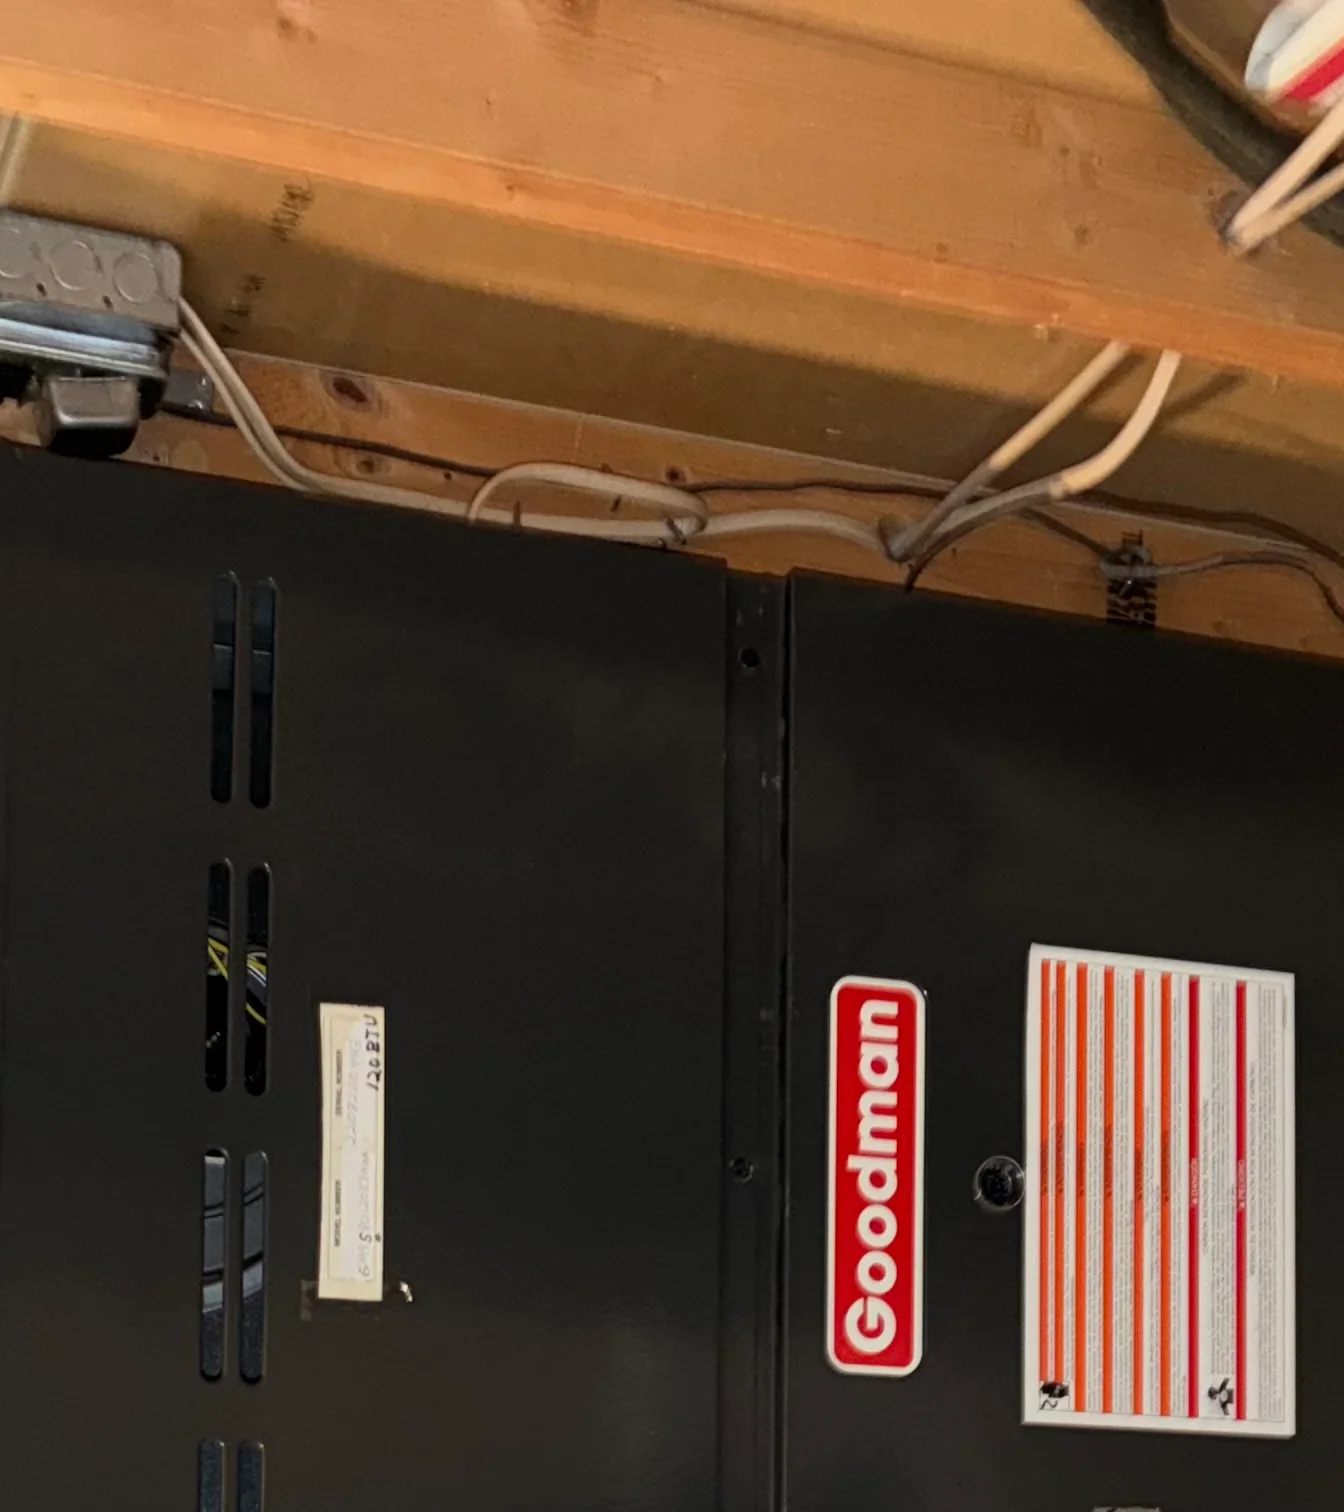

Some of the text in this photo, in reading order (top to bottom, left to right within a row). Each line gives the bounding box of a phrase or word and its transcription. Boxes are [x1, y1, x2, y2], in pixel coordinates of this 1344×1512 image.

[364, 1013, 381, 1092] 120 BTU
[844, 998, 900, 1356] Goodman
